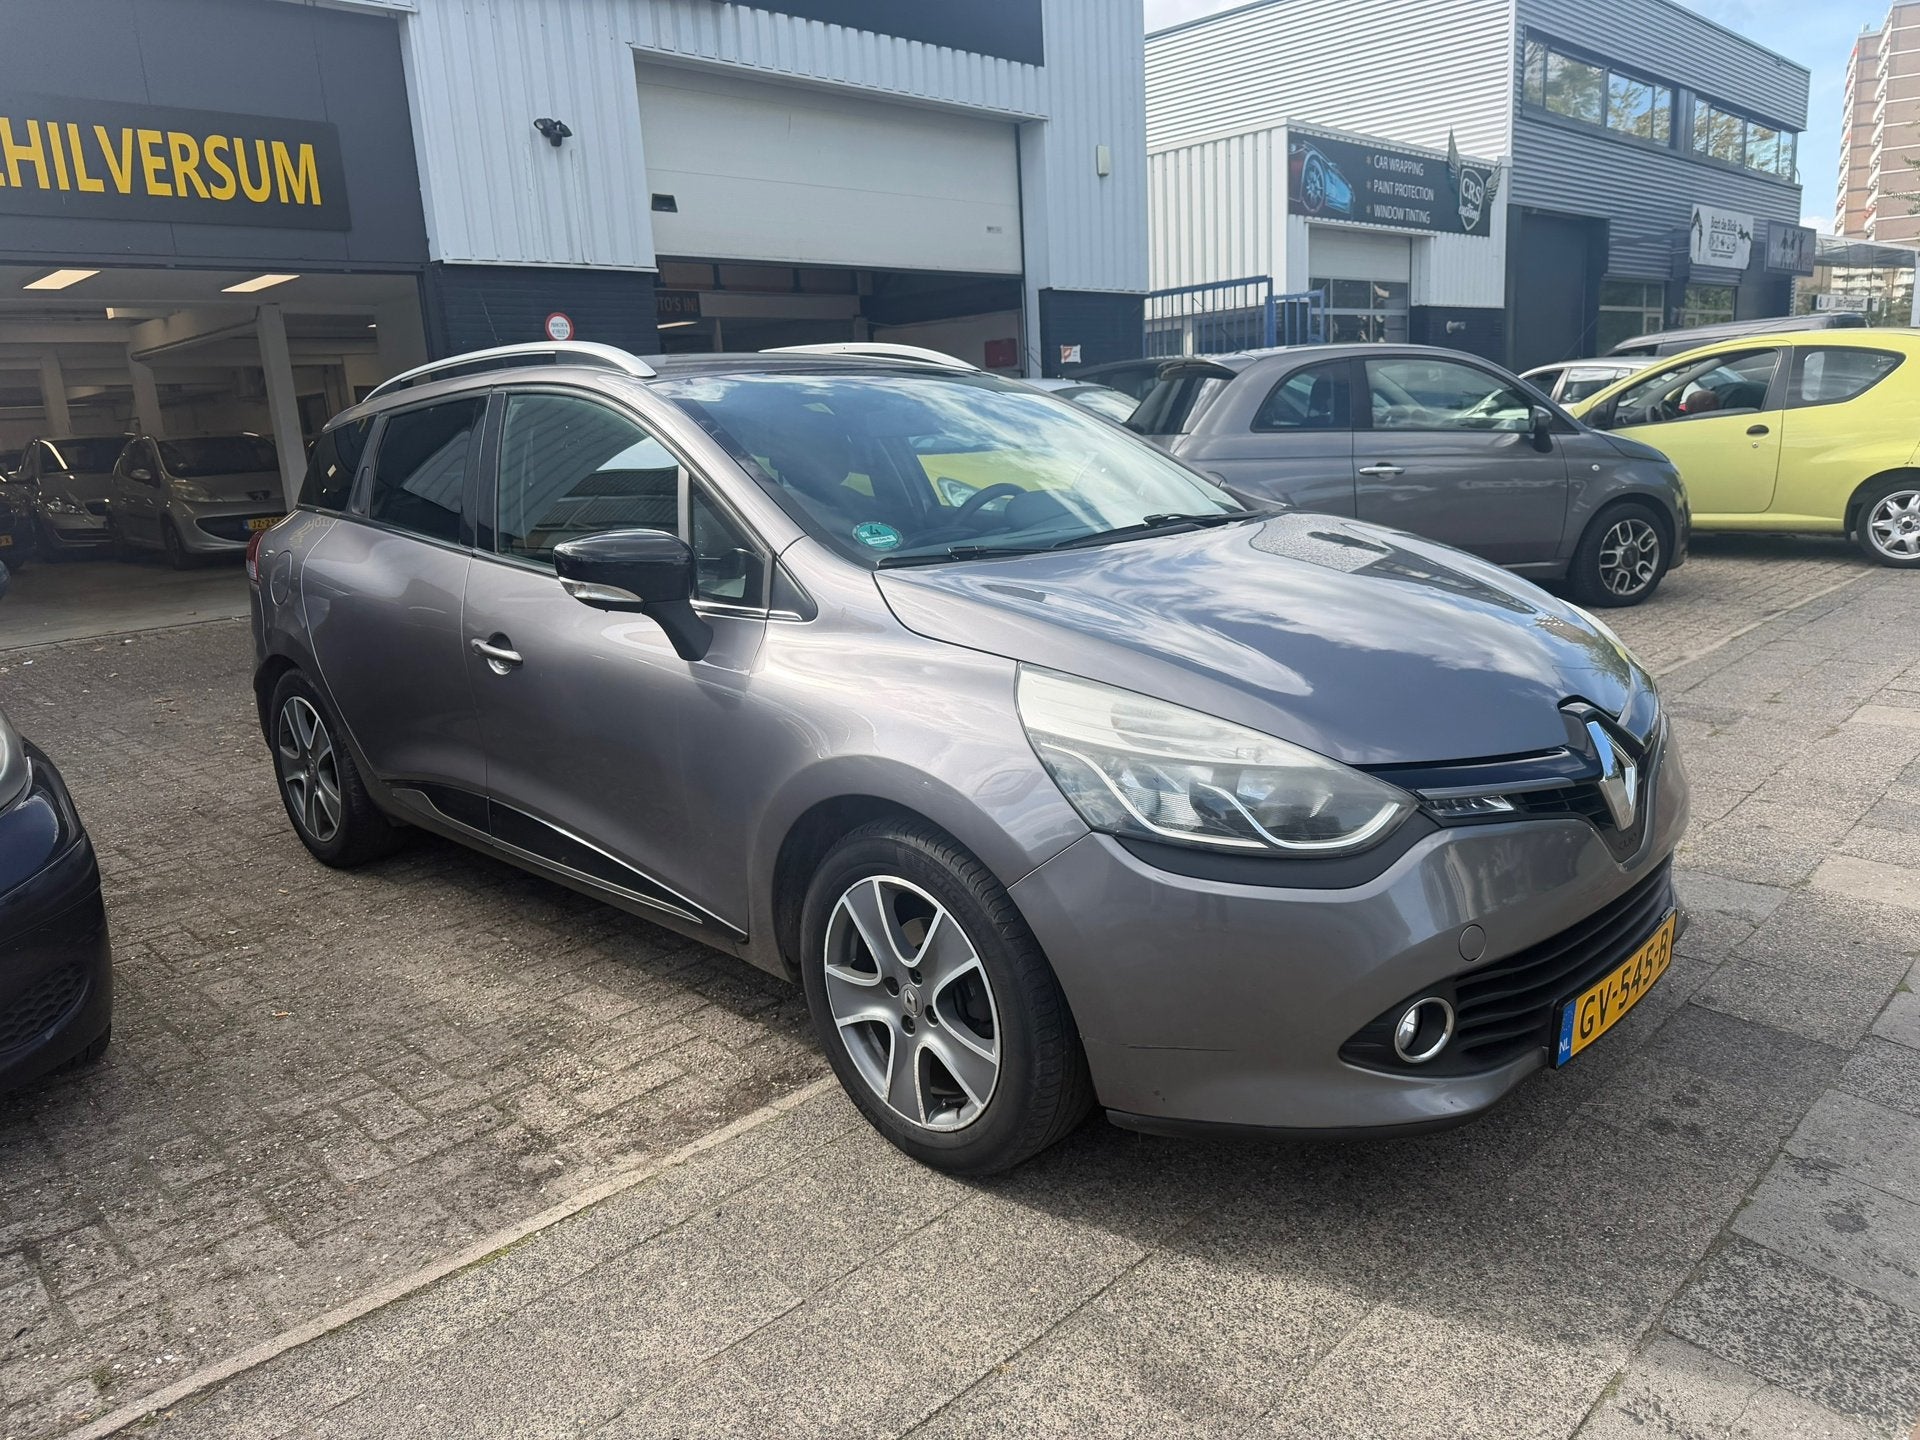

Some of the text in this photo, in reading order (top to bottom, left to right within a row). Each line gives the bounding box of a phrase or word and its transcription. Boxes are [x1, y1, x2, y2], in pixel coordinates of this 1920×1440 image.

[0, 117, 321, 206] HILVERSUM
[1374, 155, 1424, 176] CAR WRAPPING
[1374, 179, 1434, 201] PAINT PROTECTION
[1462, 178, 1481, 205] CRS
[1374, 204, 1430, 224] WINDOW TINTING
[1580, 927, 1669, 1040] GV-545-B
[1559, 1038, 1570, 1053] NL
